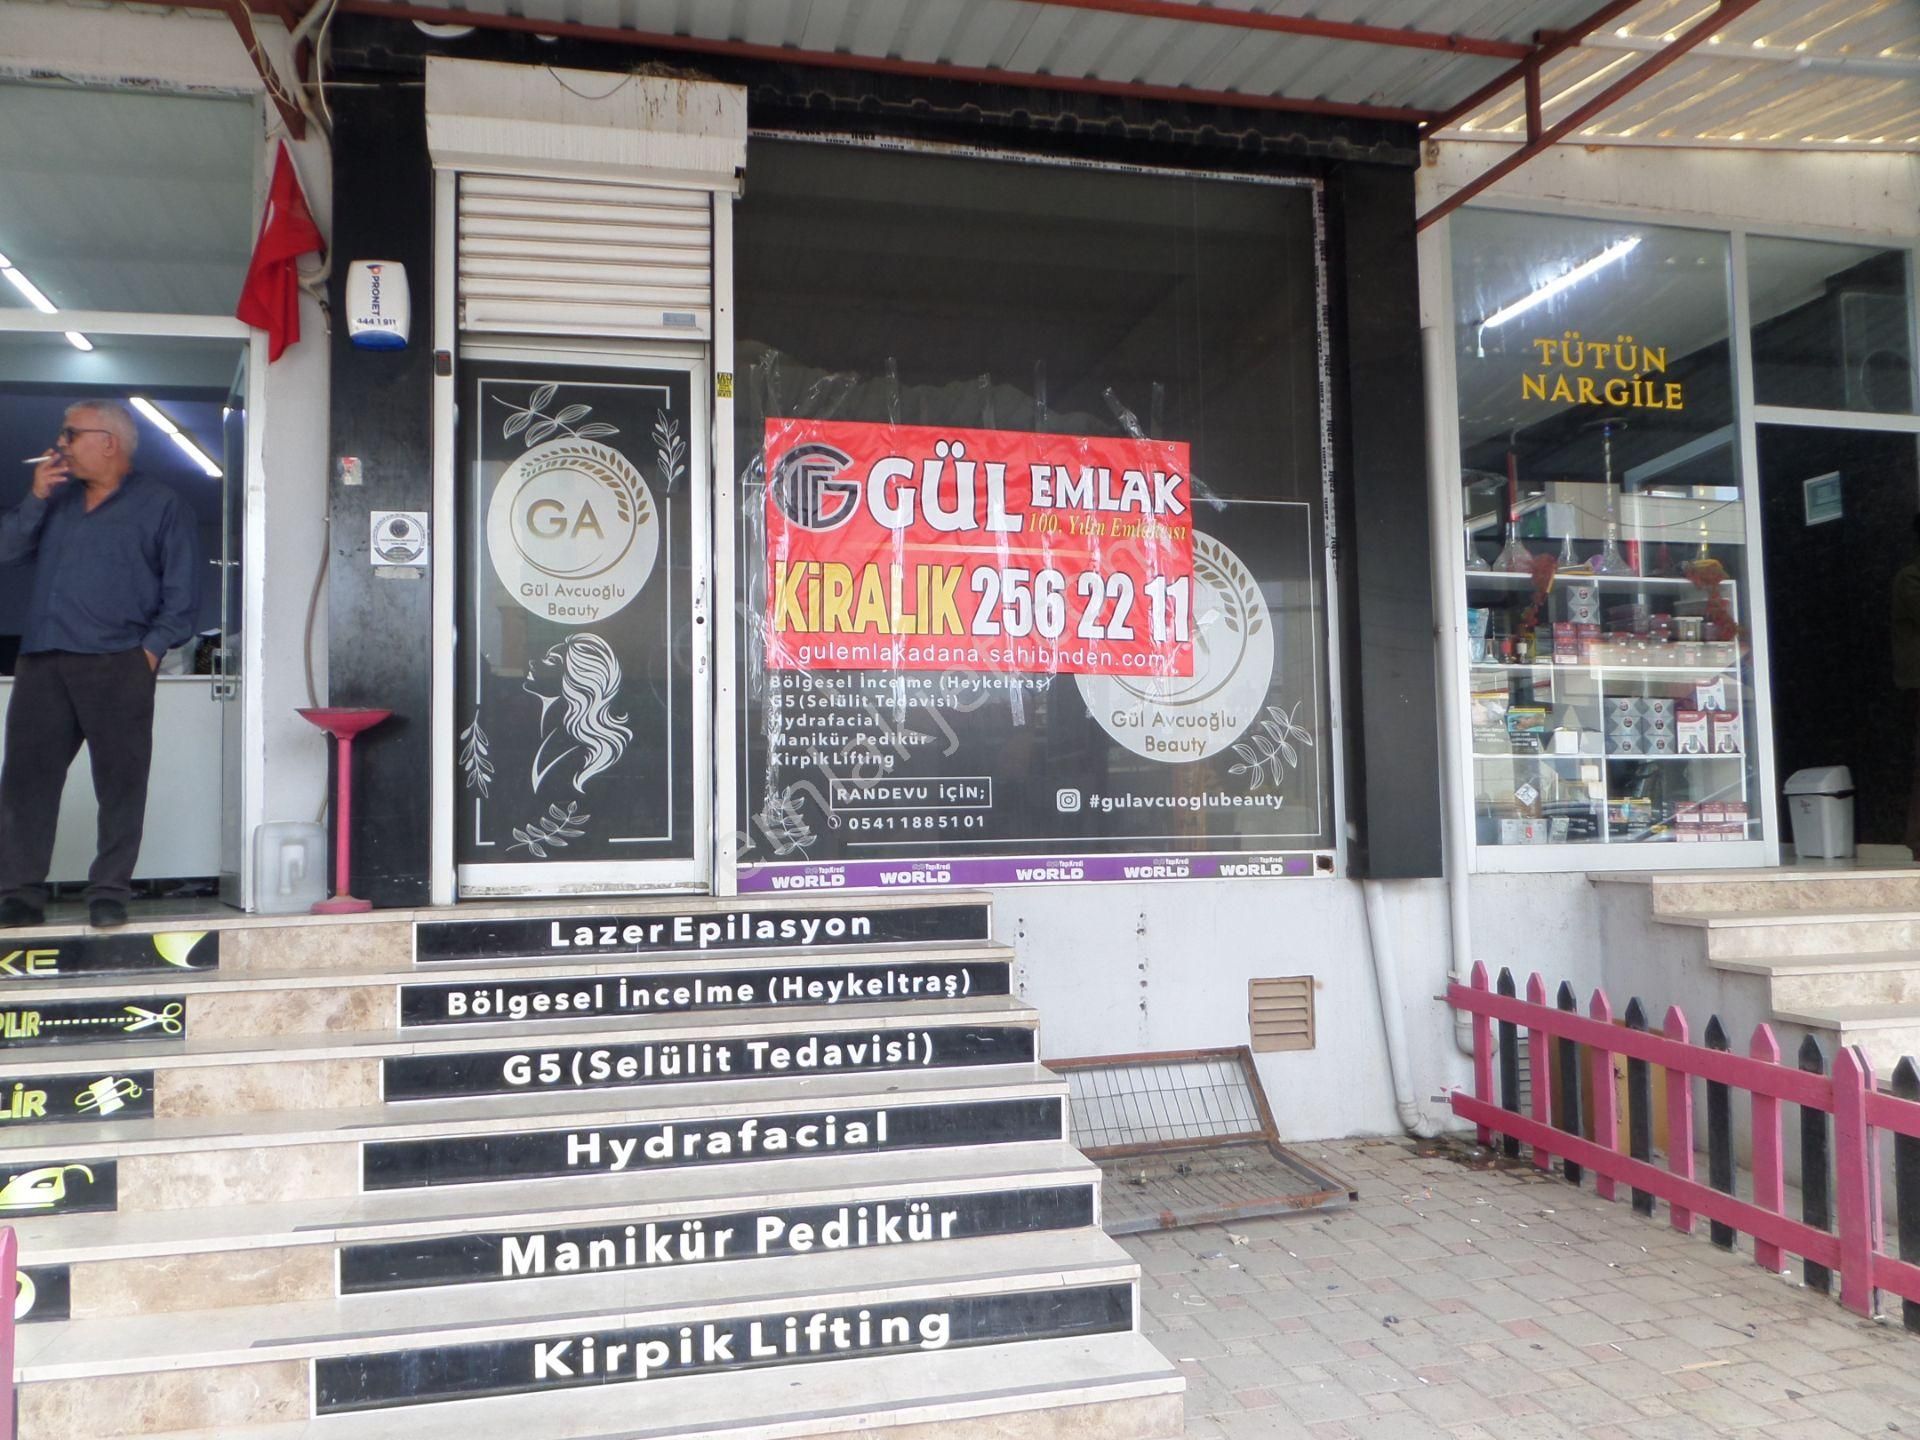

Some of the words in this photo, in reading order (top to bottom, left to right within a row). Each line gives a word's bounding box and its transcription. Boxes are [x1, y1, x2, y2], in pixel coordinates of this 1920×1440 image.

[371, 275, 380, 316] PRONET
[1533, 330, 1666, 373] TÜTÜN
[1522, 373, 1684, 410] NARGİLE
[866, 438, 1025, 533] GÜL
[1028, 463, 1187, 515] EMLAK
[526, 498, 605, 540] GA
[1028, 511, 1063, 534] 100.
[520, 582, 549, 598] Gül
[553, 583, 626, 600] Avcuoğlu
[547, 602, 600, 619] Beauty
[970, 564, 1067, 639] 256
[1076, 570, 1135, 641] 22
[1144, 574, 1190, 642] 11
[770, 674, 852, 691] Bölgesel
[771, 713, 880, 730] Hydrafacial
[1111, 710, 1145, 728] Gül
[1152, 710, 1237, 731] Avcuoğlu
[772, 732, 849, 746] Manikür
[856, 731, 928, 746] Pedikür
[1145, 736, 1207, 756] Beauty
[837, 786, 929, 800] RANDEVU
[940, 783, 985, 802] İÇİN;
[1089, 792, 1284, 812] #gulavcuoglubeauty
[880, 870, 951, 884] WORLD
[1016, 867, 1084, 880] WORLD
[1124, 866, 1189, 878] WORLD
[1219, 864, 1283, 876] WORLD
[772, 874, 845, 889] WORLD
[551, 919, 664, 948] Lazer
[673, 912, 872, 949] Epilasyon
[447, 984, 604, 1019] Bölgesel
[619, 978, 755, 1007] İncelme
[768, 968, 972, 1003] (Heykeltraş)
[746, 1031, 934, 1072] Tedavisi)
[566, 1111, 888, 1171] Hydrafacial
[501, 1221, 734, 1277] Manikür
[756, 1202, 958, 1255] Pedikür
[534, 1324, 734, 1379] Kirpik
[748, 1310, 951, 1357] Lifting
